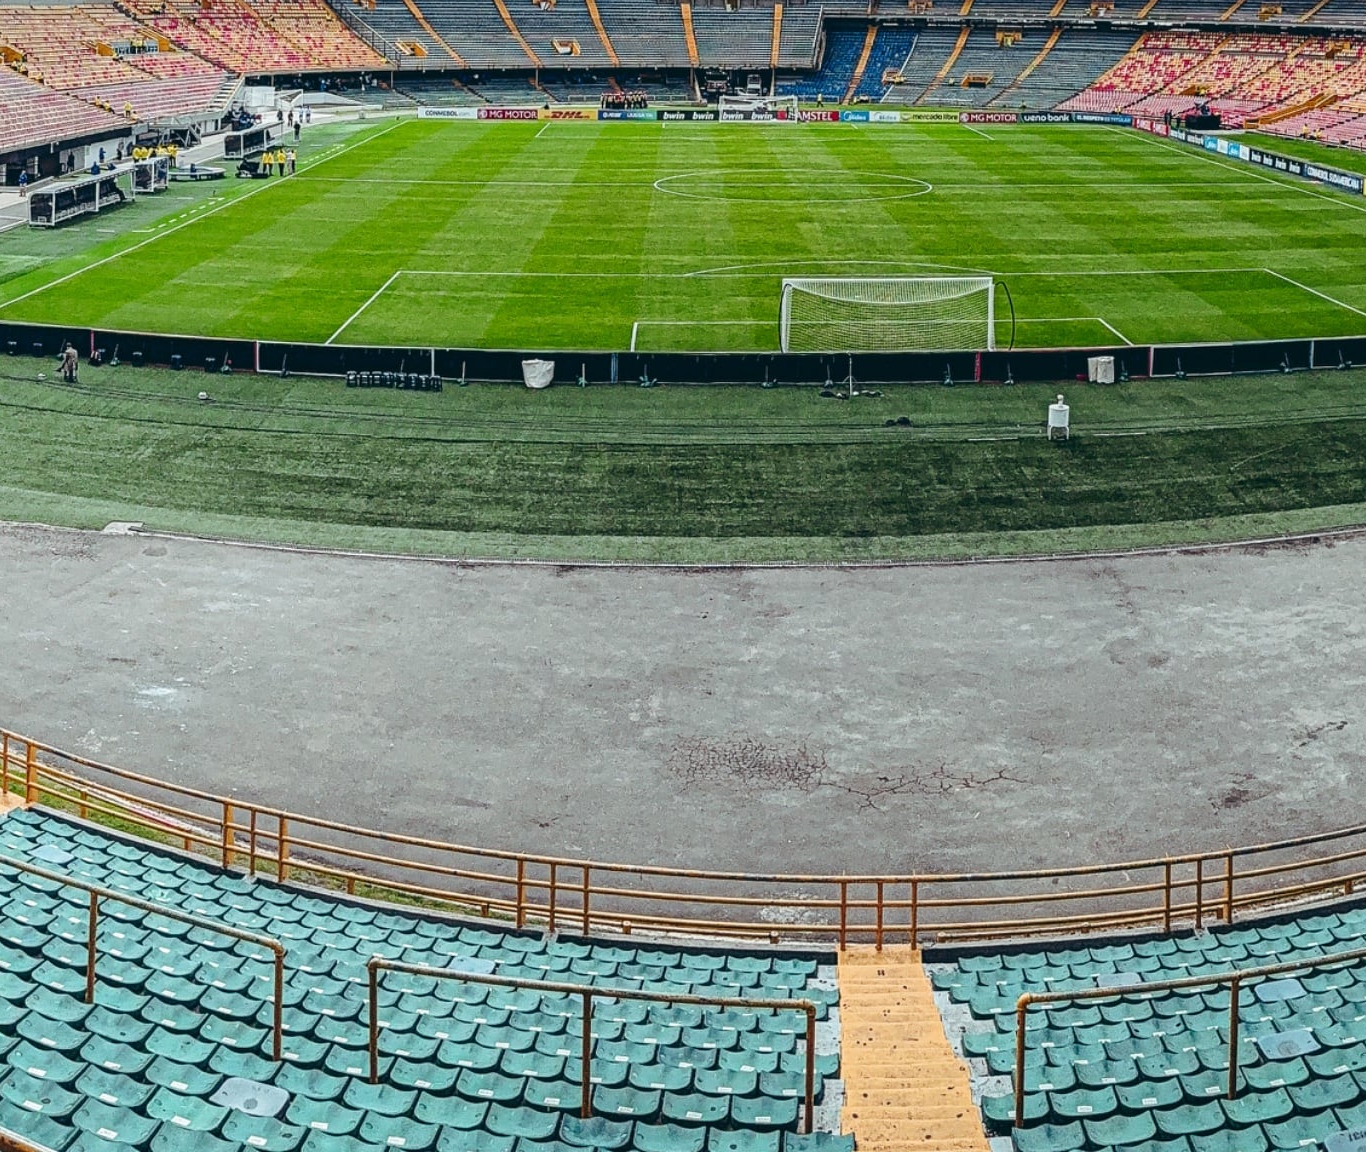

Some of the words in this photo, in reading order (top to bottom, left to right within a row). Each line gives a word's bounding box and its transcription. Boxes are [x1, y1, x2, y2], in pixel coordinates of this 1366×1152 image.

[504, 110, 537, 119] MOTOR
[550, 111, 584, 119] DHL
[663, 111, 685, 120] bwin
[692, 111, 714, 120] bwin
[722, 111, 744, 120] bwin
[751, 111, 773, 120] bwin
[912, 113, 942, 121] mercado
[943, 113, 958, 121] libre
[986, 113, 1017, 122] MOTOR
[1024, 113, 1046, 122] ueno
[1048, 112, 1070, 122] bank
